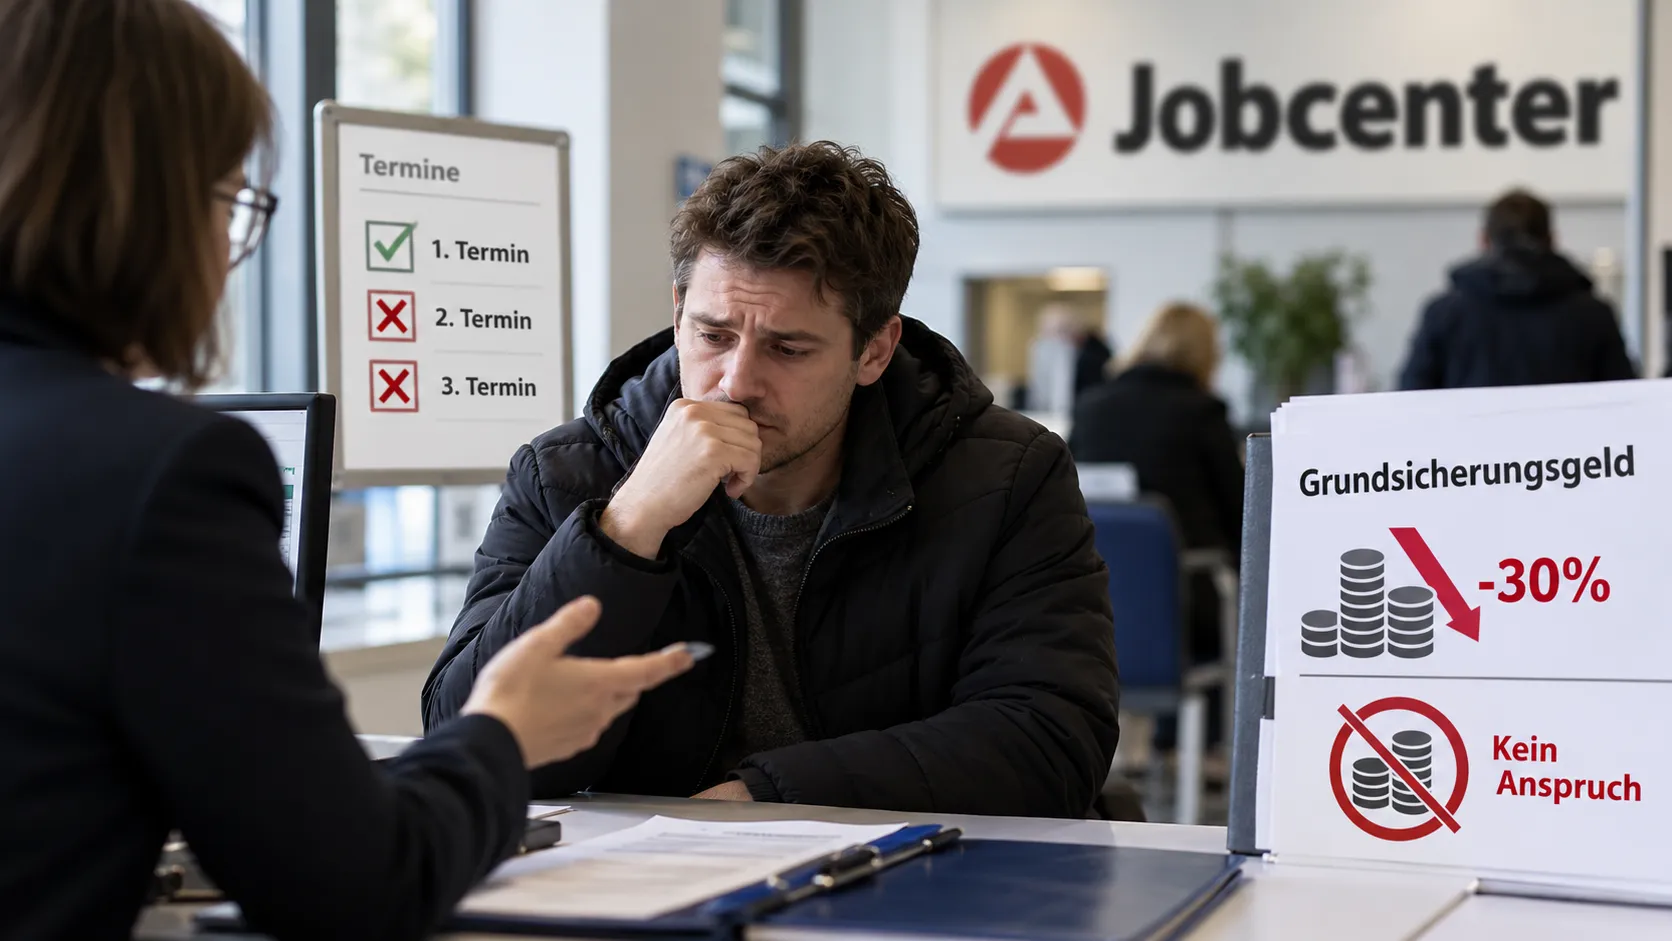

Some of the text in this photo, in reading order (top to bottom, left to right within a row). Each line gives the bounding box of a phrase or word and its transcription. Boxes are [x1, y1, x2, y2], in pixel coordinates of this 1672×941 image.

[1113, 57, 1620, 154] Jobcenter
[359, 153, 460, 183] Termine
[432, 239, 530, 264] 1. Termin
[435, 307, 532, 330] 2. Termin
[441, 376, 537, 397] 3. Termin
[1299, 444, 1635, 497] Grundsicherungsgeld
[1478, 555, 1611, 604] -30%
[1493, 734, 1557, 763] Kein
[1496, 769, 1642, 805] Anspruch
